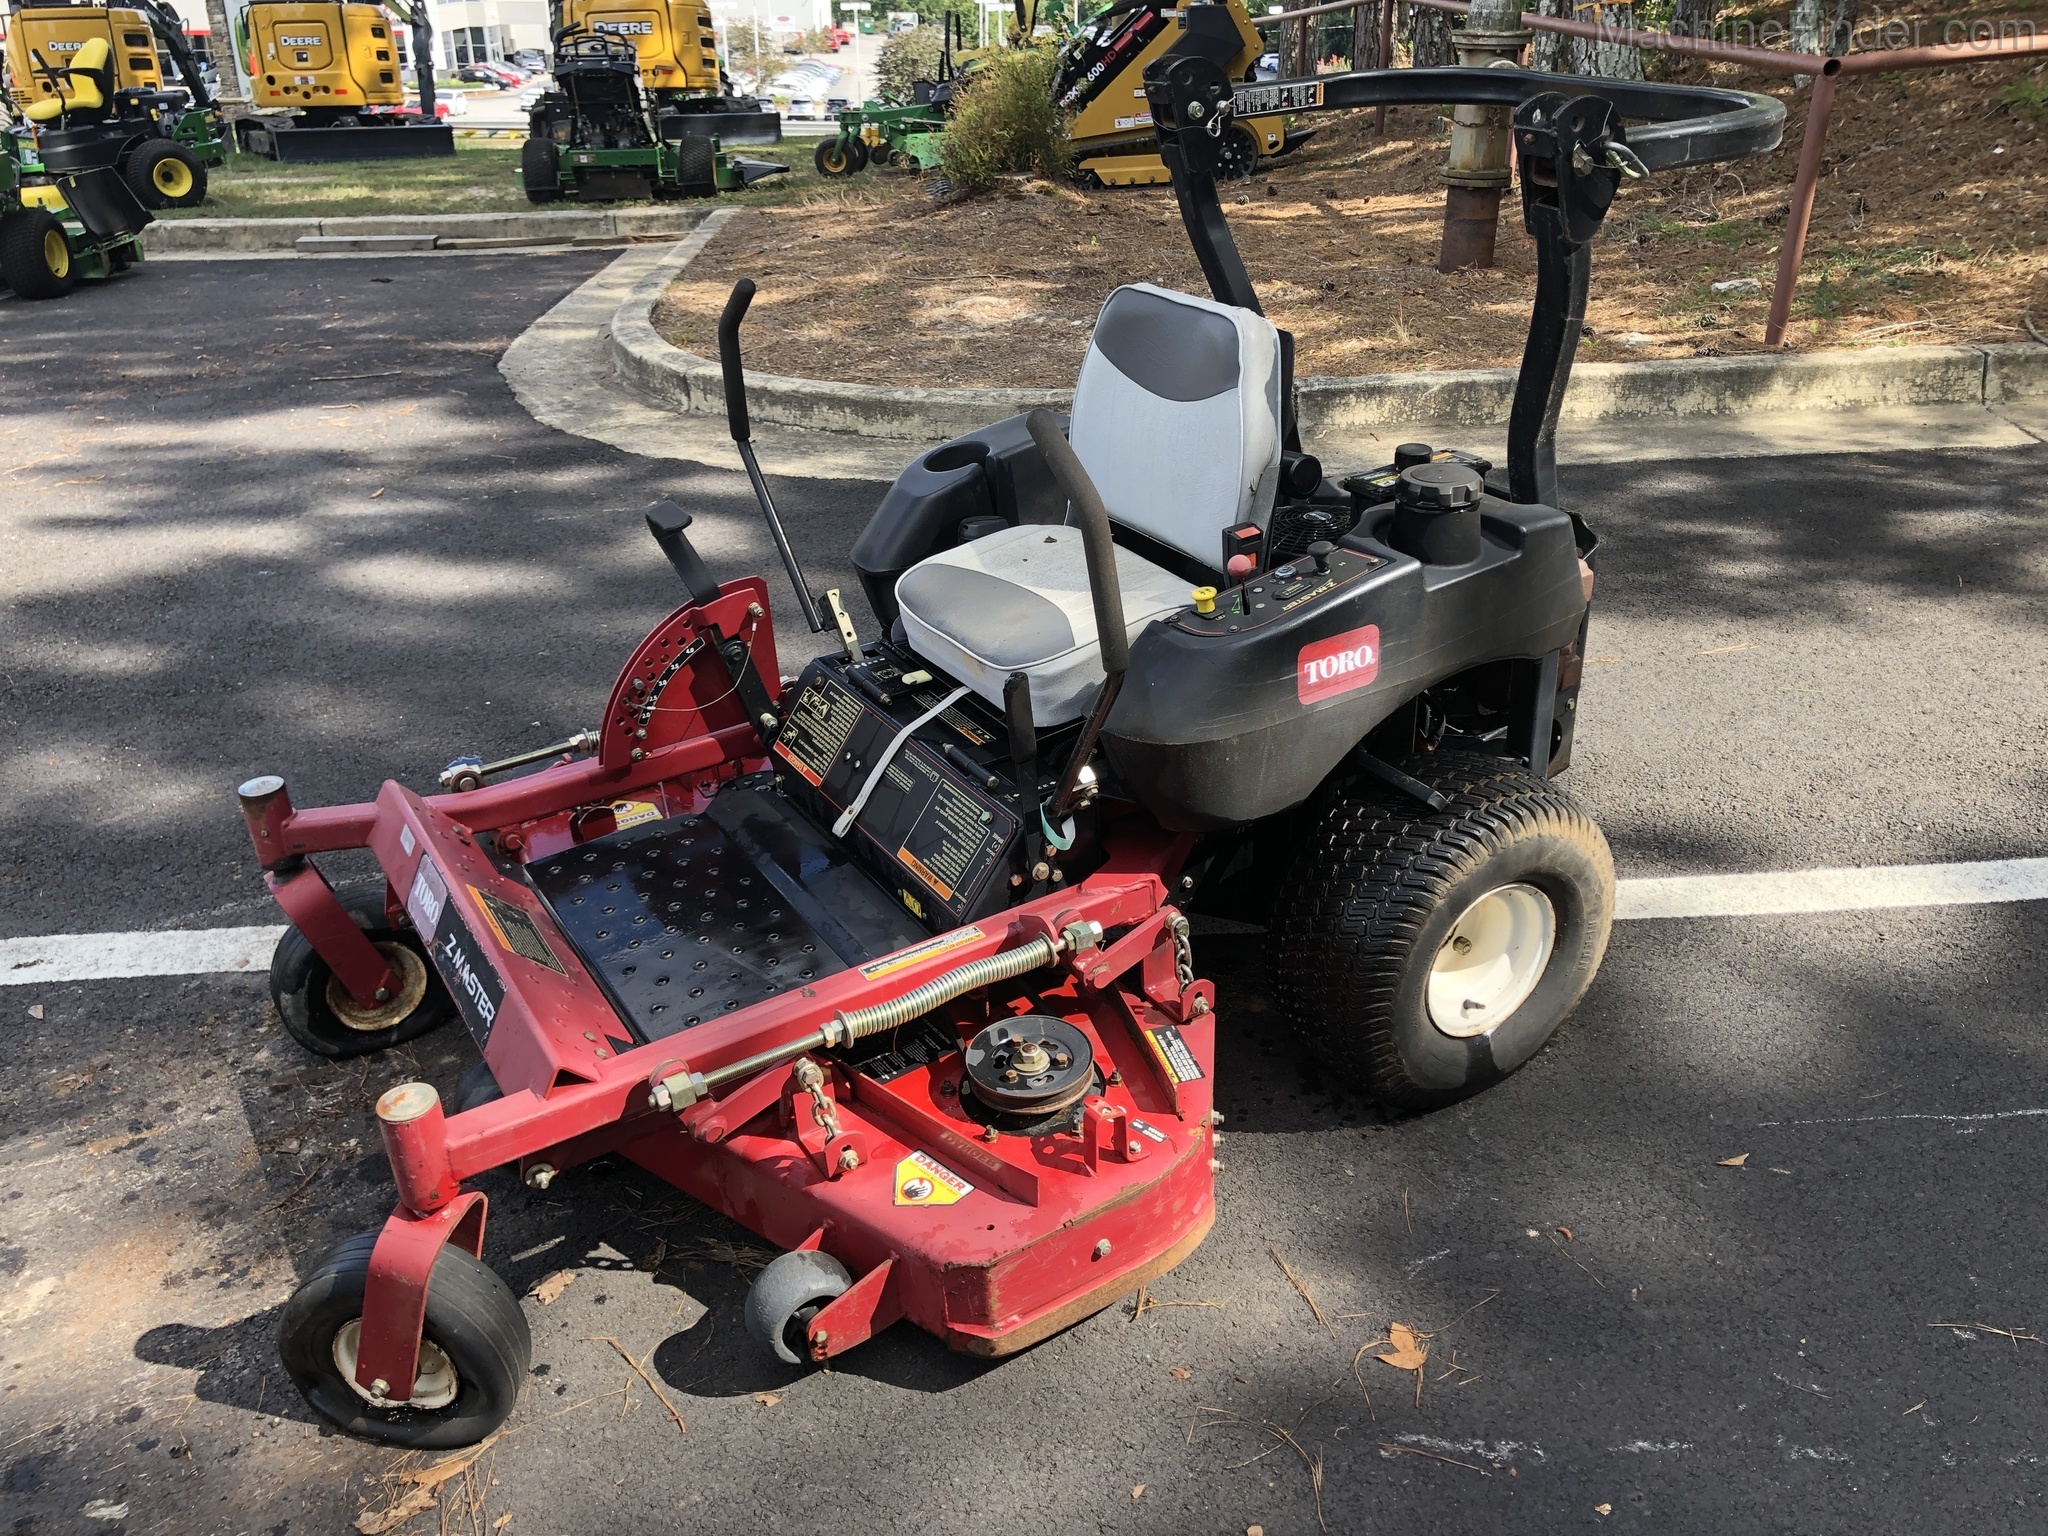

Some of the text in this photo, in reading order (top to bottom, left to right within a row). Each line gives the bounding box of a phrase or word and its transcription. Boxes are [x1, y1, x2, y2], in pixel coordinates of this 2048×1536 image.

[594, 21, 653, 36] DEERE
[48, 41, 87, 52] DEER
[280, 36, 322, 46] DEERE
[1087, 51, 1117, 82] 600HD
[1303, 645, 1376, 685] TORO
[616, 811, 655, 825] DANG
[909, 858, 933, 882] WARNING
[414, 872, 440, 926] TORO
[914, 1154, 966, 1191] DANGER
